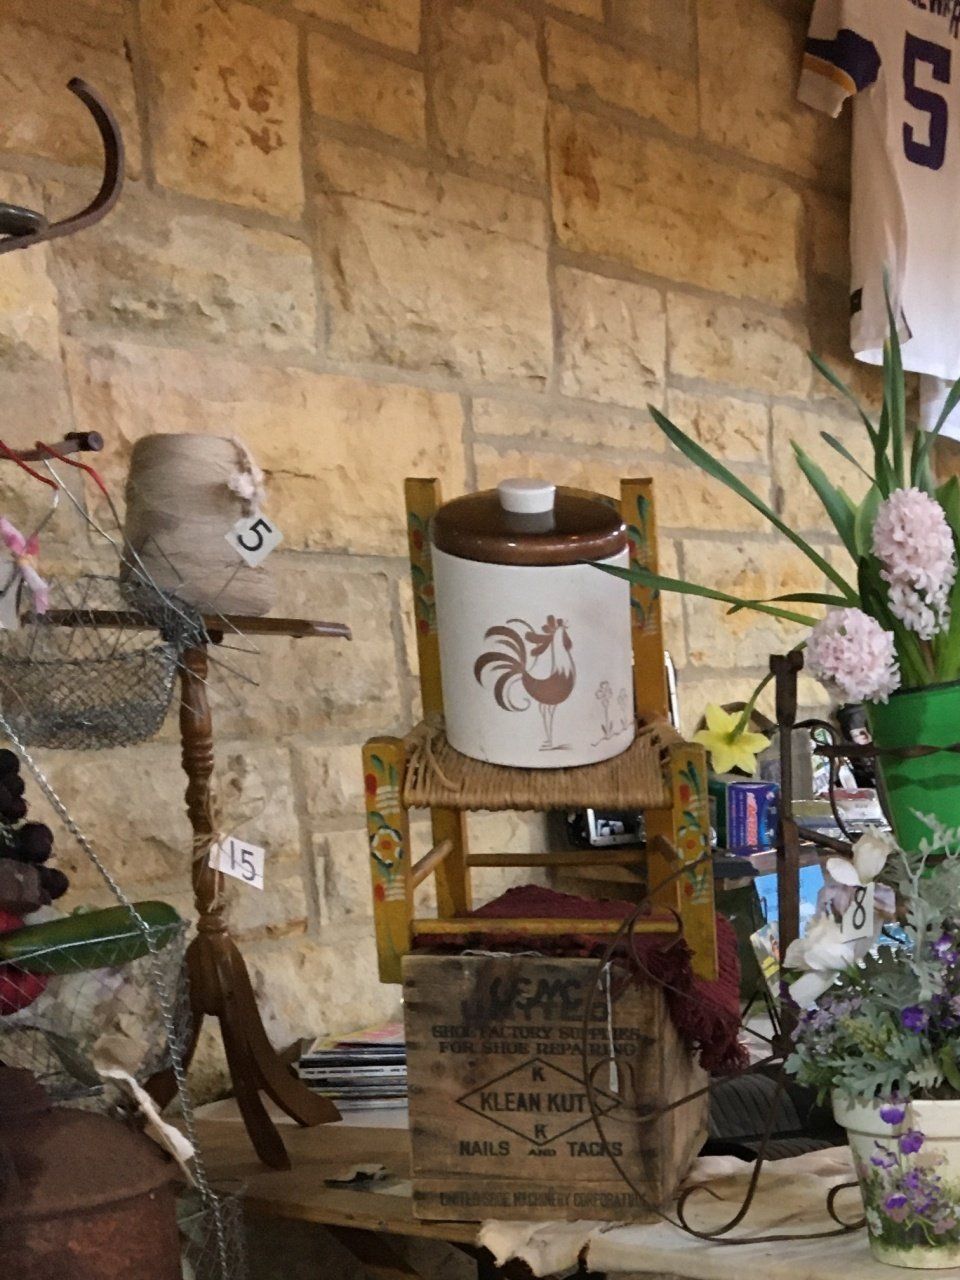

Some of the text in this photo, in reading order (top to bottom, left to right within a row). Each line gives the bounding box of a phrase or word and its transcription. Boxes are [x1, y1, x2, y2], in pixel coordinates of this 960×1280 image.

[903, 30, 952, 171] 5
[237, 518, 273, 552] 5
[230, 840, 256, 882] 15
[536, 1042, 636, 1056] REPARING
[532, 1067, 546, 1082] K
[480, 1092, 587, 1113] KLEAN KUT
[534, 1124, 549, 1139] K
[459, 1141, 623, 1157] NAILS AND TACKS
